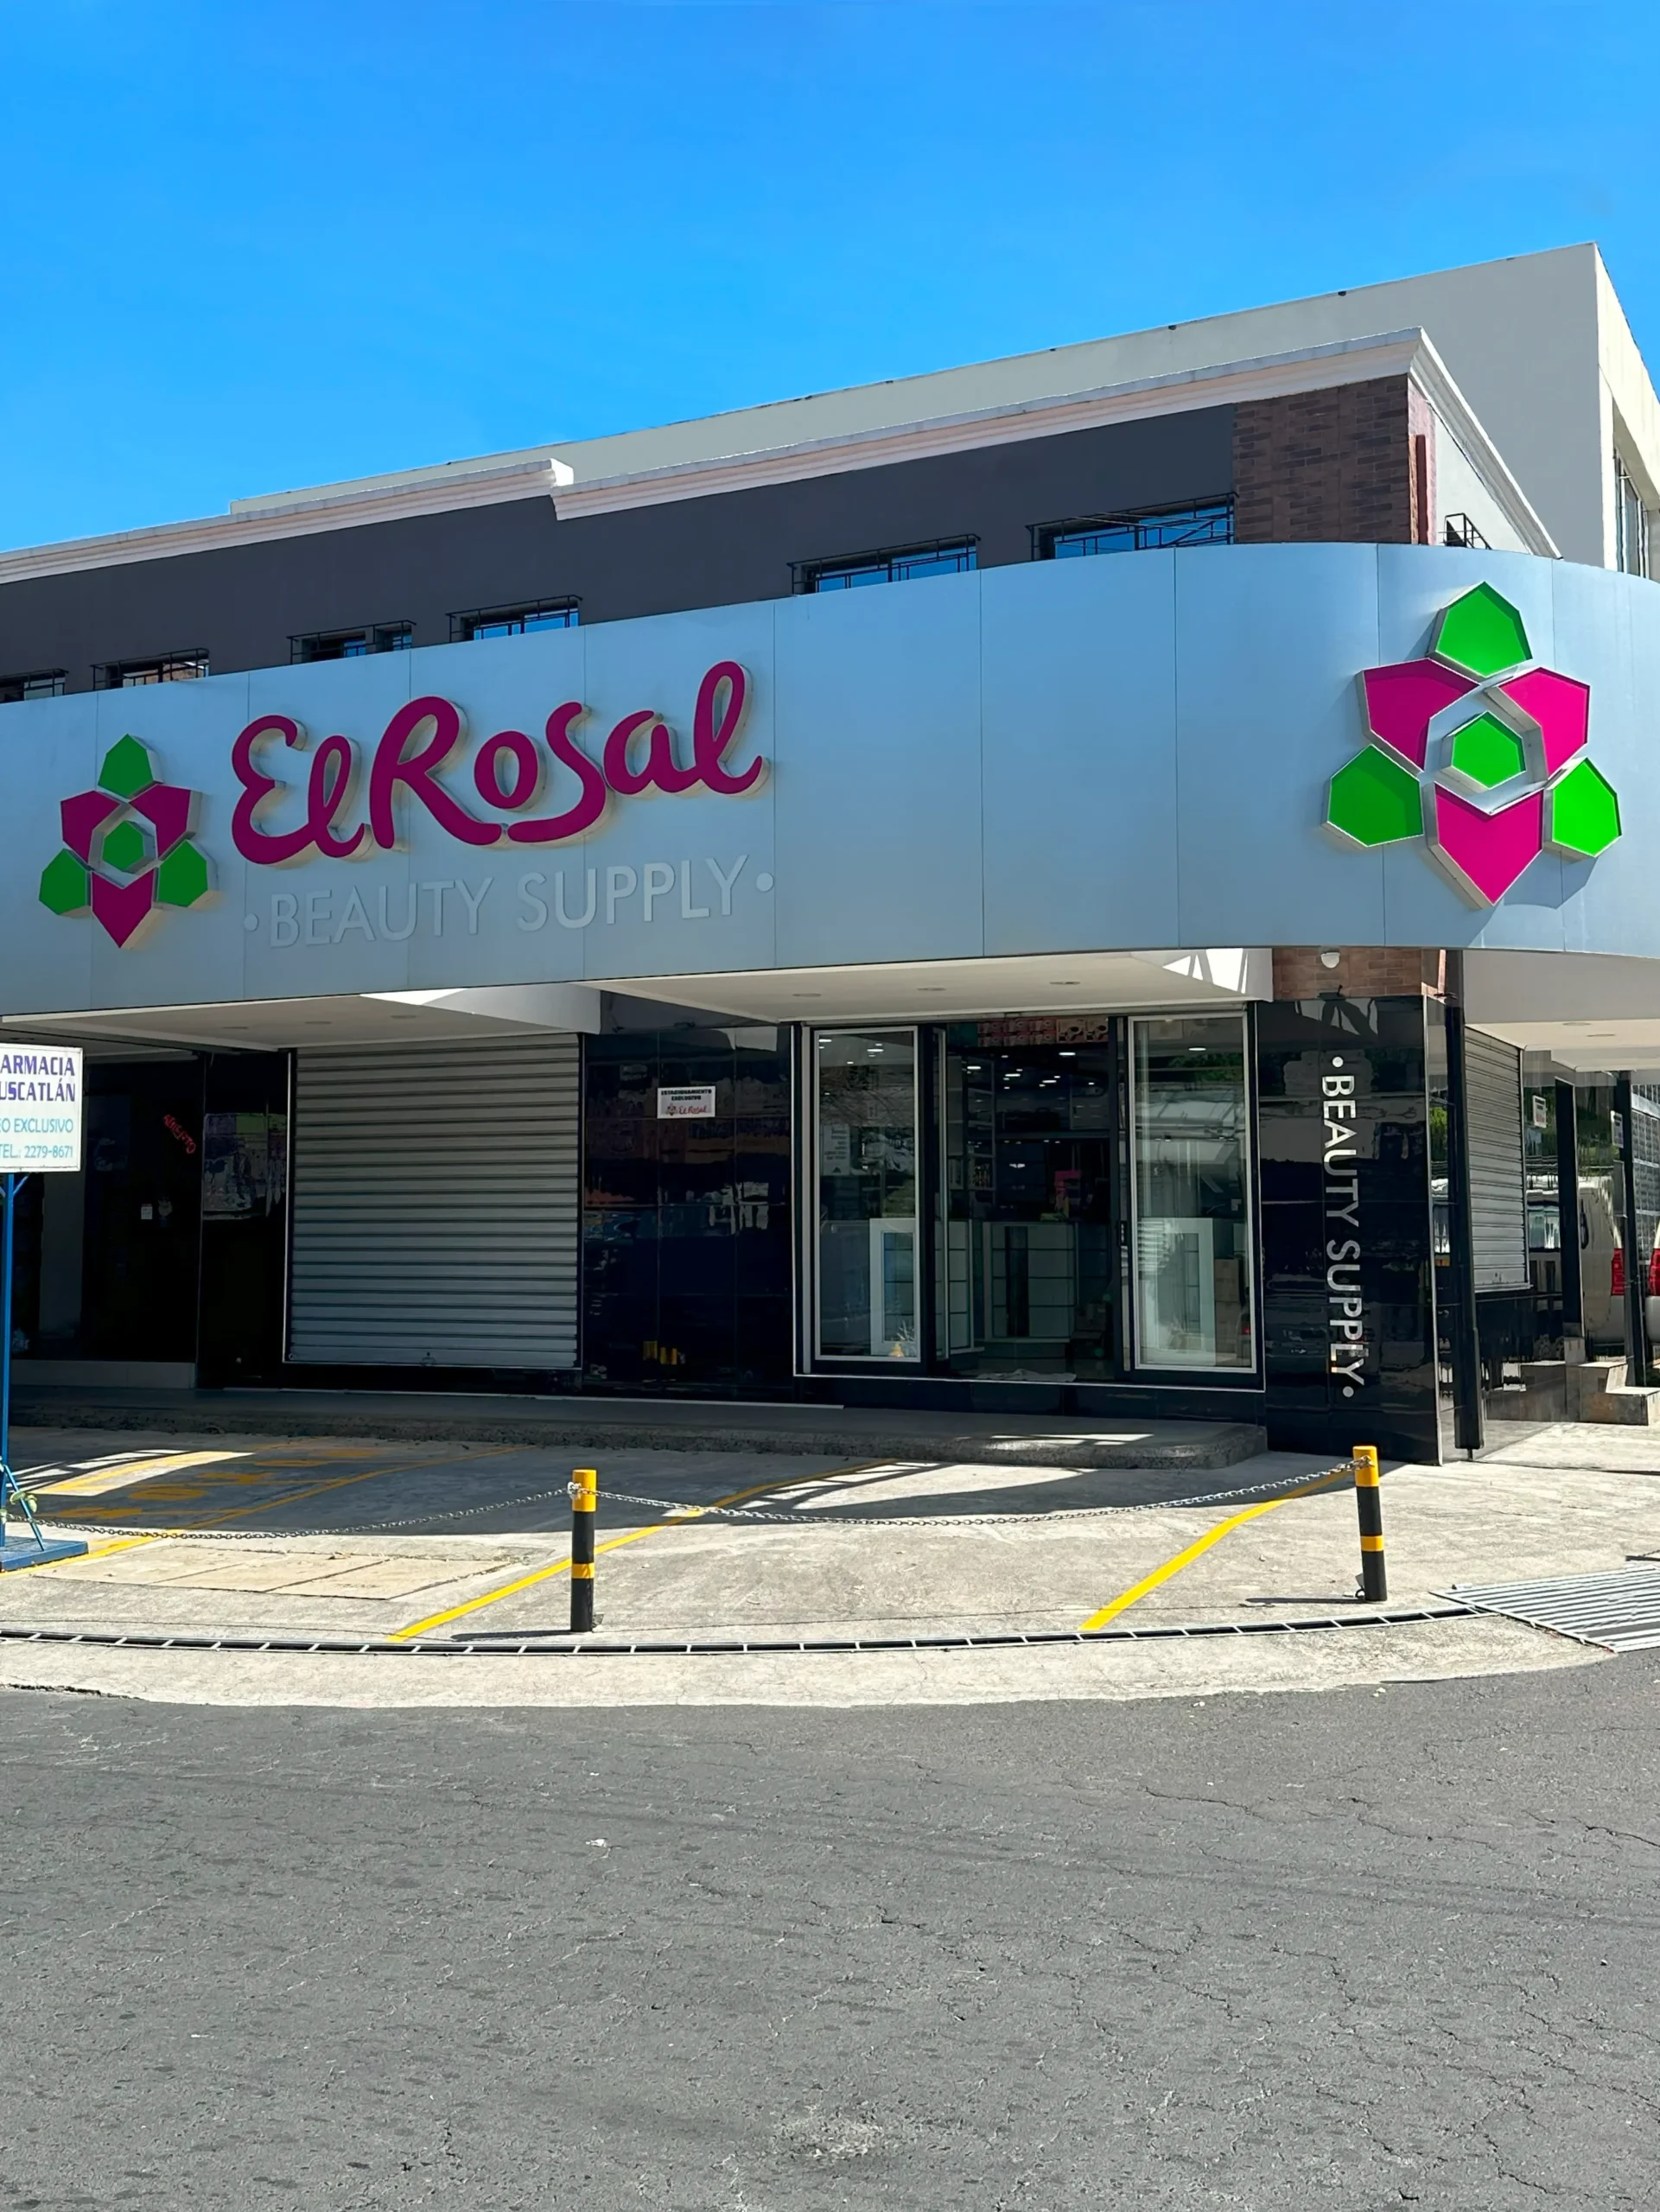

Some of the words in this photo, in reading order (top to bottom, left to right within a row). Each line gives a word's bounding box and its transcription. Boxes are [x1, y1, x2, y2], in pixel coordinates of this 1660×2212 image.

[269, 876, 494, 949] BEAUTY
[517, 855, 751, 933] SUPPLY
[14, 1117, 73, 1133] EXCLUSIVO
[24, 1144, 73, 1159] 2279-8671
[1321, 1075, 1359, 1227] BEAUTY
[1326, 1239, 1364, 1386] SUPPLY
